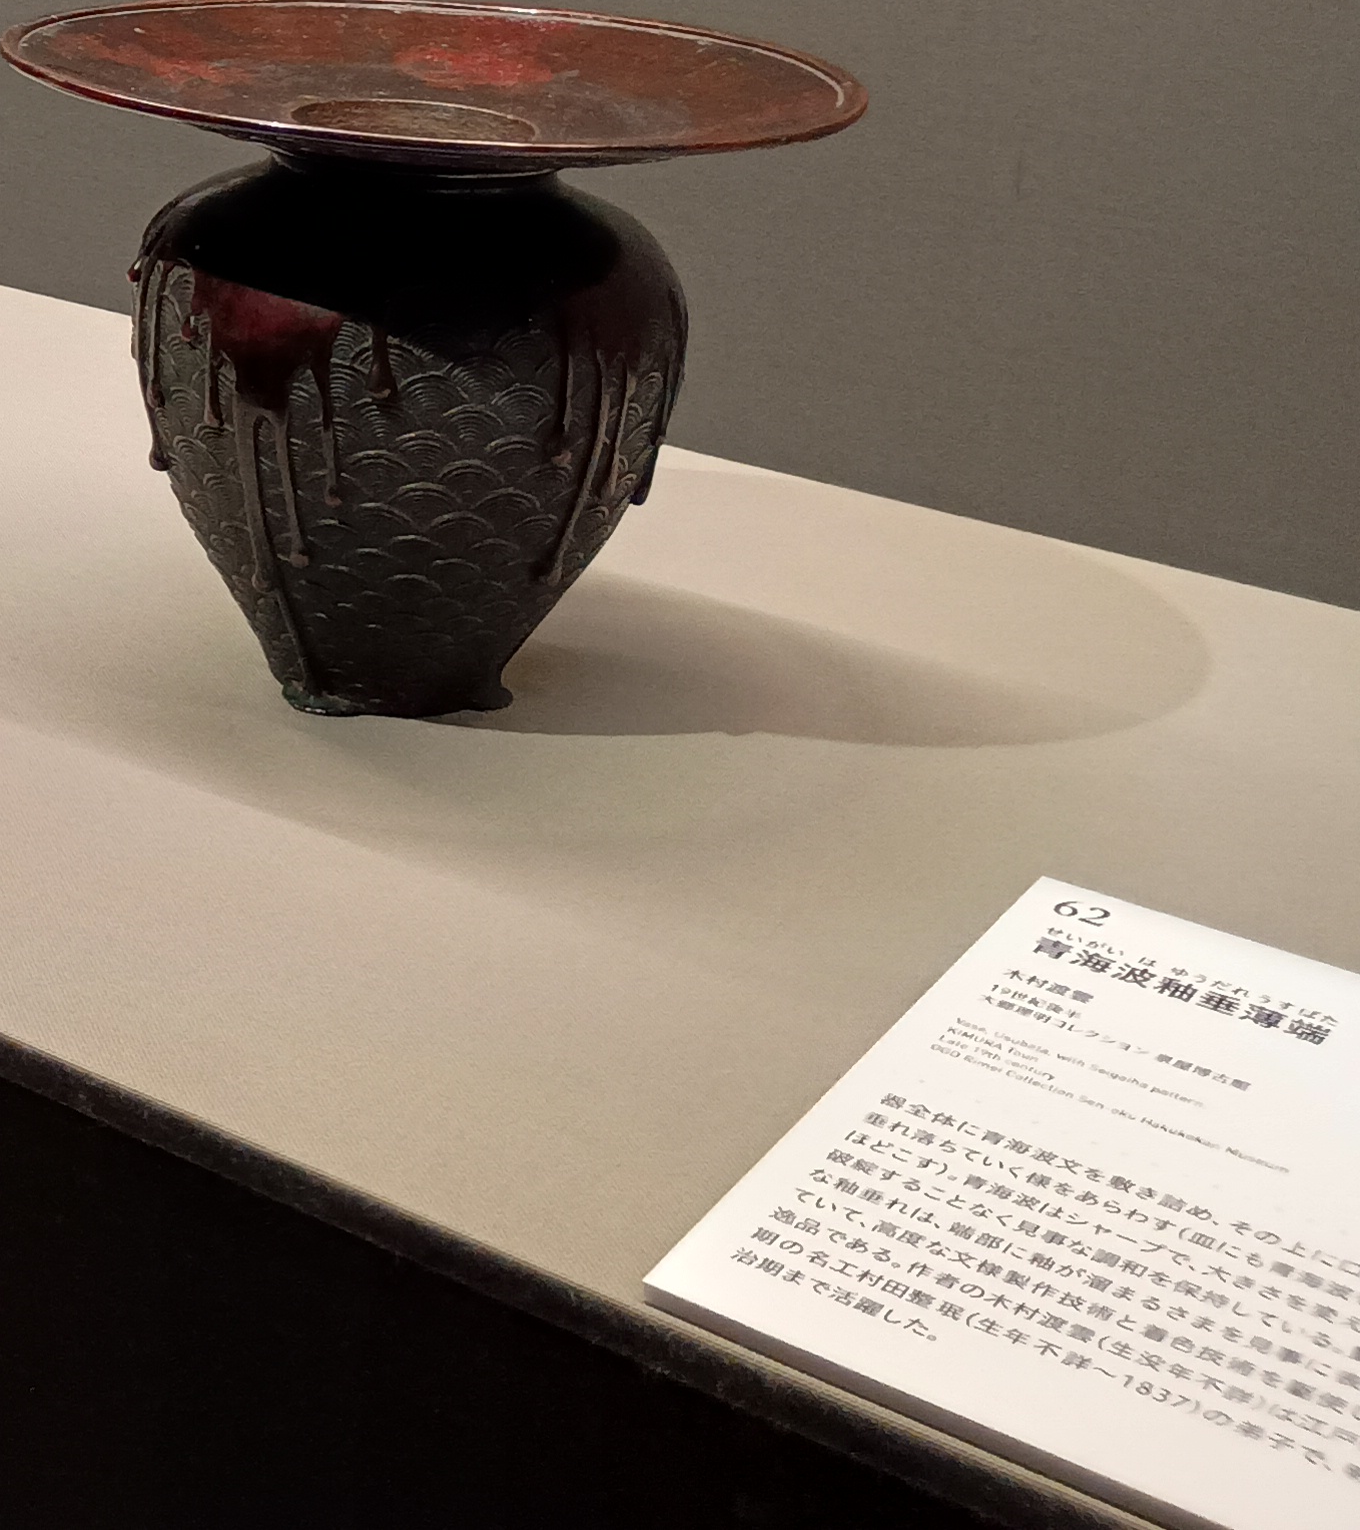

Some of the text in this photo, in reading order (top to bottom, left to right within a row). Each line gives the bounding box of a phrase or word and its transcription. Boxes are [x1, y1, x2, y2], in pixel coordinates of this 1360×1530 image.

[1053, 901, 1111, 927] 62
[947, 1026, 1002, 1051] KIMURA
[938, 1034, 968, 1050] Late
[1004, 1058, 1055, 1081] century
[1056, 1052, 1086, 1068] with
[1005, 1069, 1074, 1099] Collection
[730, 1246, 937, 1342] 治期まで活躍した。
